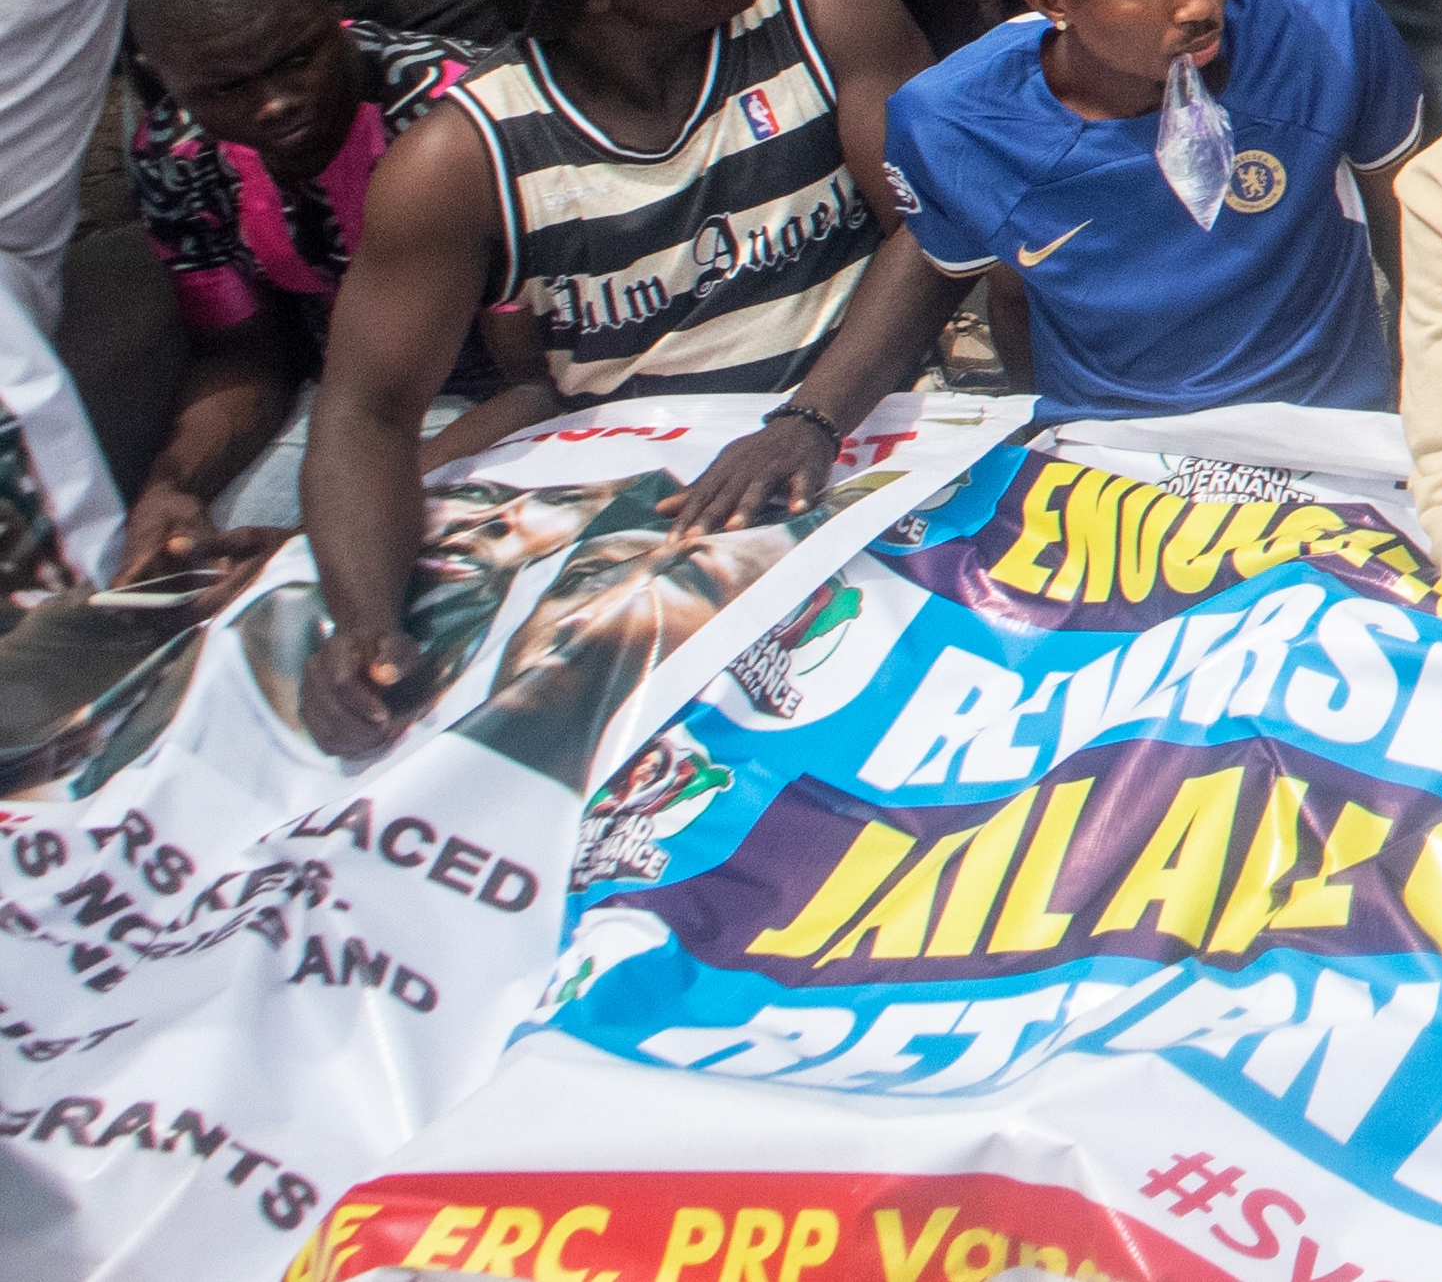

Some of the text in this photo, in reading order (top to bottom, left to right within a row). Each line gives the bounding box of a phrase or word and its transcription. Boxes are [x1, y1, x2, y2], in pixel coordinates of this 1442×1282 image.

[750, 778, 1099, 968] JAIL
[1091, 764, 1391, 957] ALL
[288, 934, 440, 1015] AND
[654, 1207, 841, 1282] PRP
